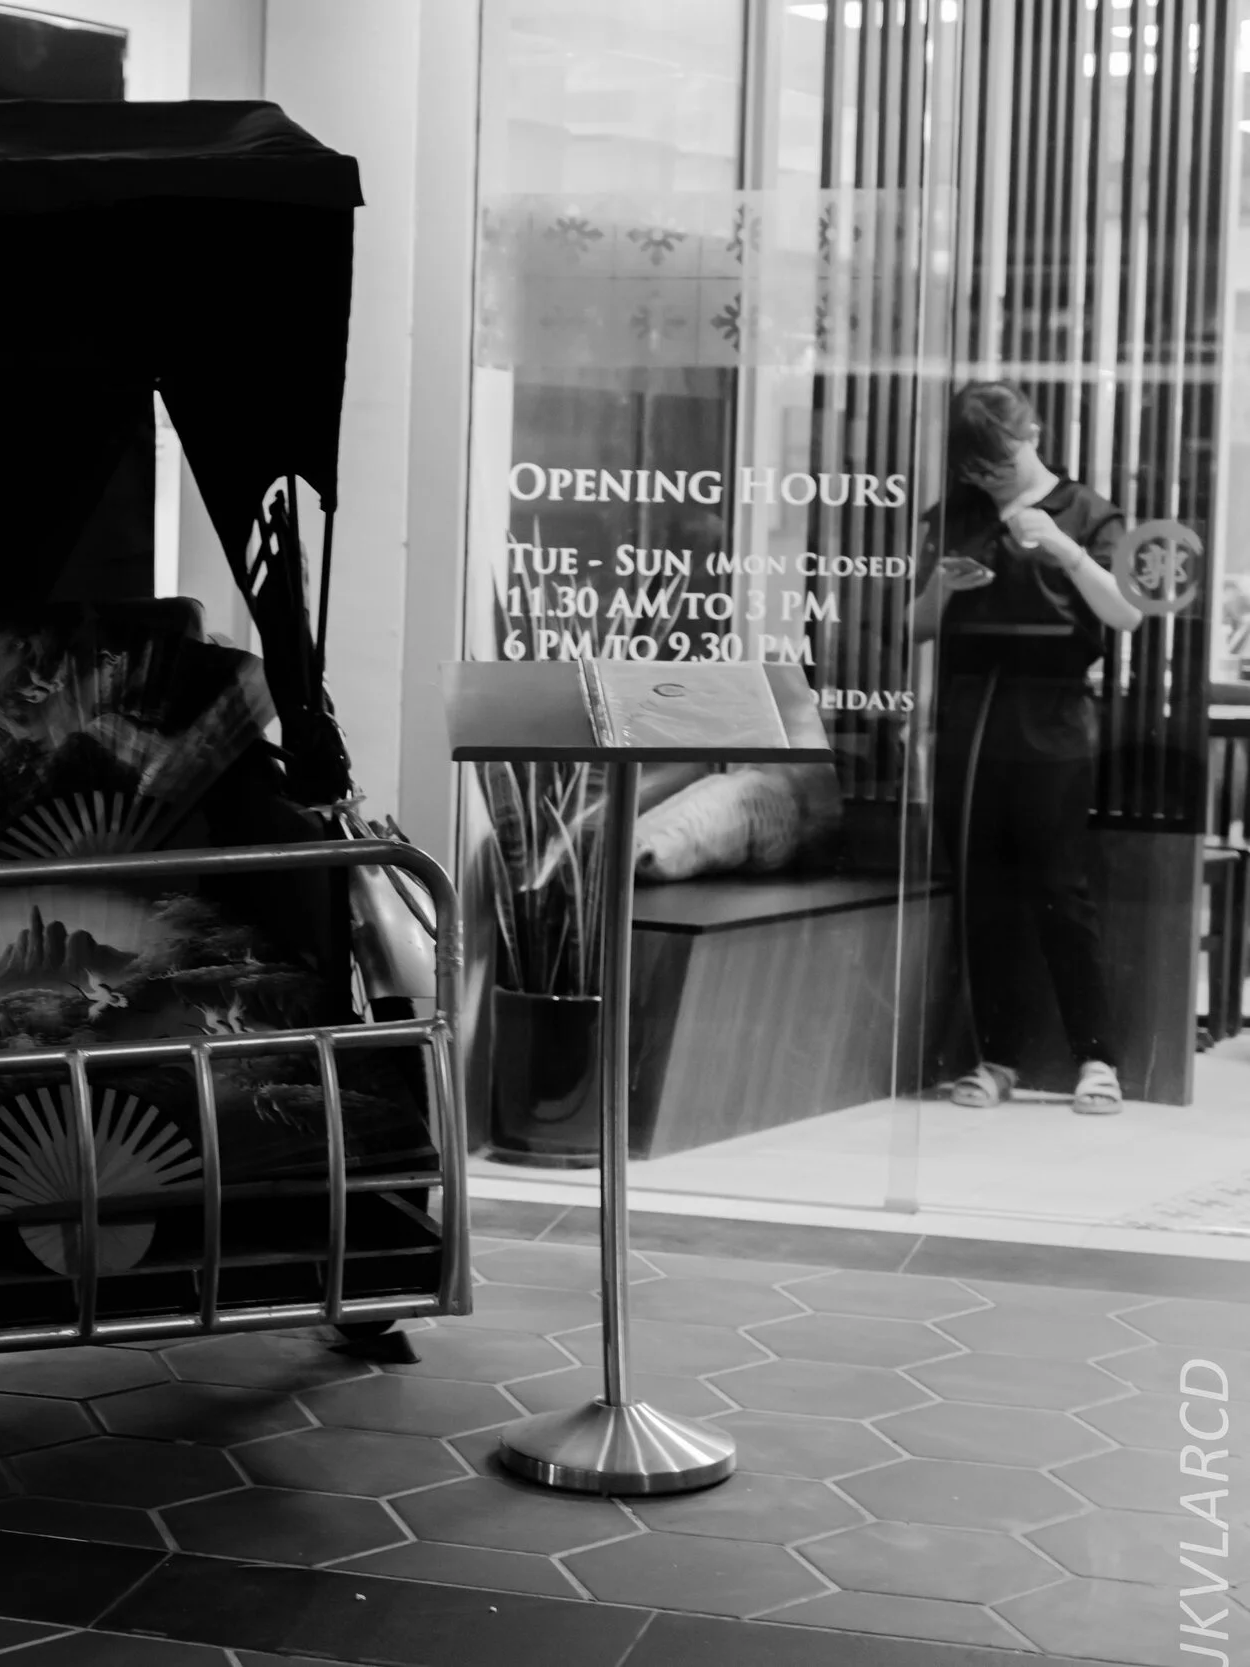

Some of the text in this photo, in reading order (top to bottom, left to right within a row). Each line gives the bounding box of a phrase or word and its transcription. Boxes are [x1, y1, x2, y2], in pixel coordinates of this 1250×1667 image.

[508, 462, 907, 507] OPENING HOURS
[507, 543, 578, 575] TUE
[615, 544, 692, 577] SUN
[706, 551, 786, 577] (MON
[796, 552, 914, 578] CLOSED)
[508, 586, 841, 622] 11.30 AM TO 3 PM
[503, 629, 816, 666] 6 PM TO 9.30 PM
[810, 688, 914, 712] LIDAYS
